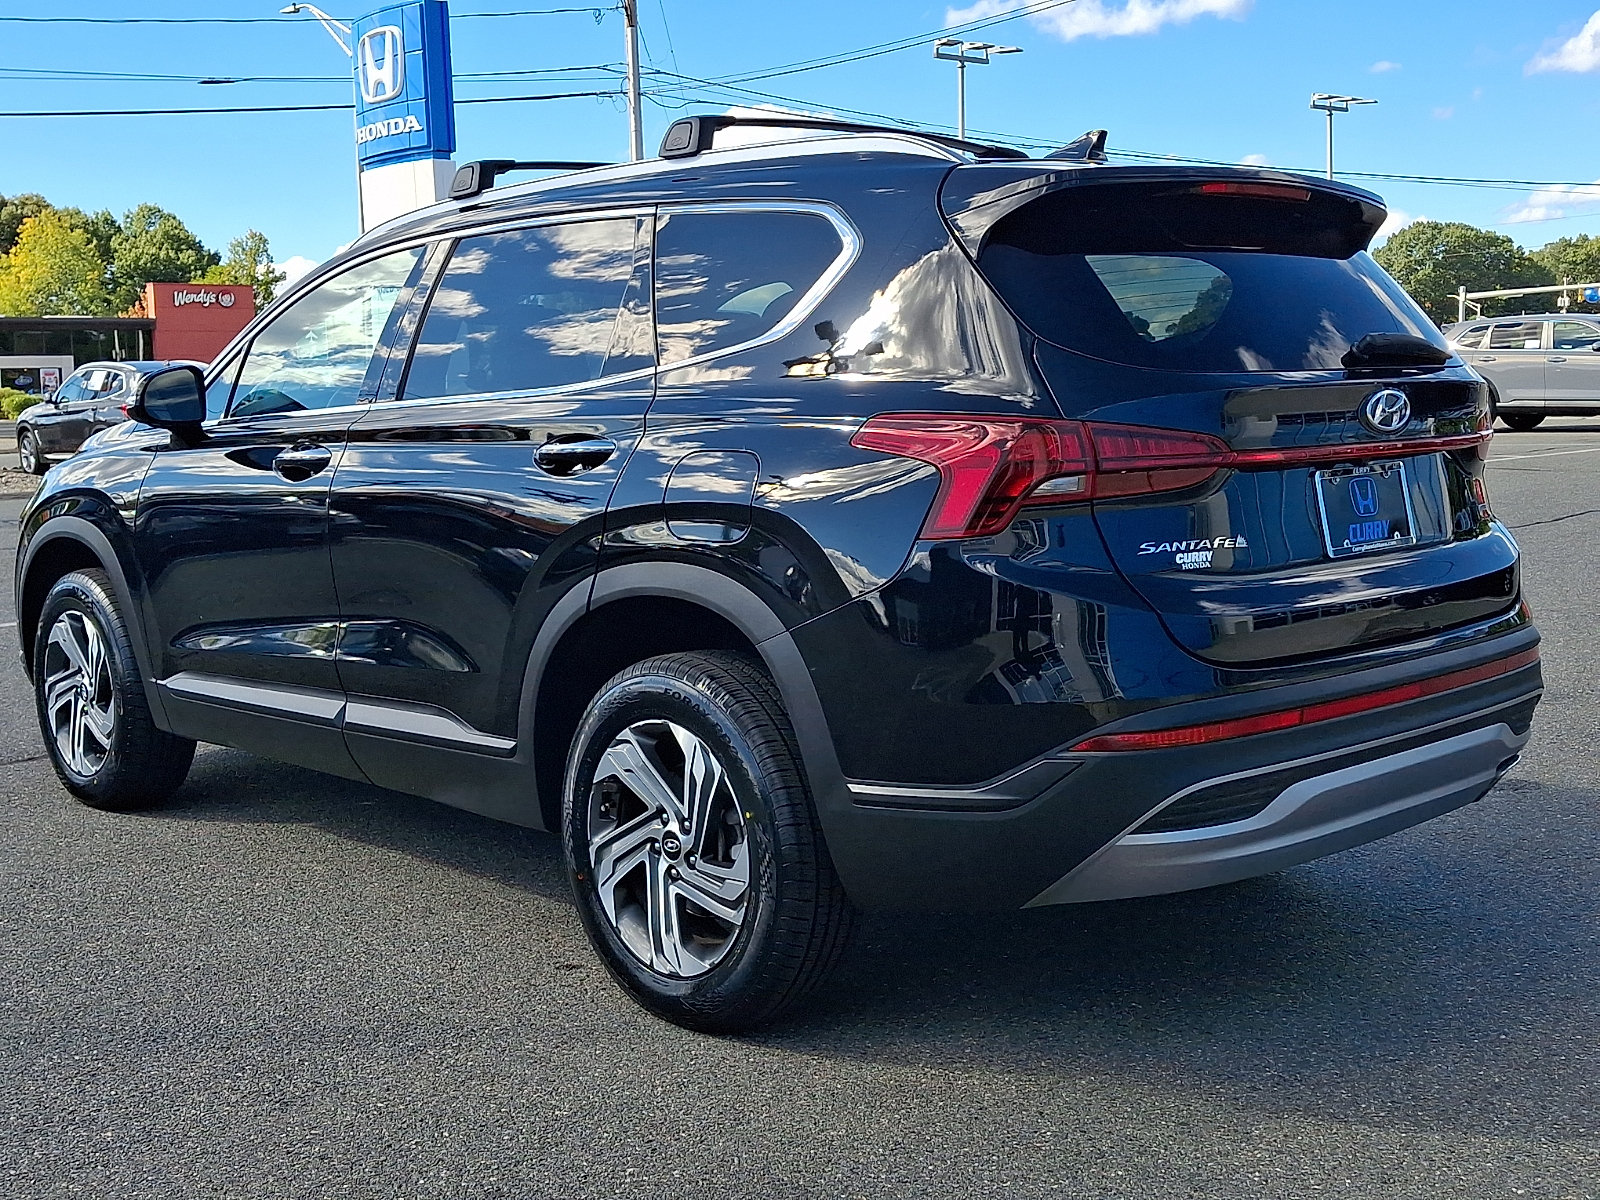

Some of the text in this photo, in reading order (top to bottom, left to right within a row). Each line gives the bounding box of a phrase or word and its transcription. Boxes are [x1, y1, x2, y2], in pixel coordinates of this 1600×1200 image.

[356, 115, 423, 145] HONDA
[173, 288, 217, 307] Wendy's
[1349, 519, 1390, 543] CURRY
[1137, 536, 1236, 556] SANTA FE
[1175, 550, 1213, 564] CURRY
[1182, 561, 1212, 570] HONDA
